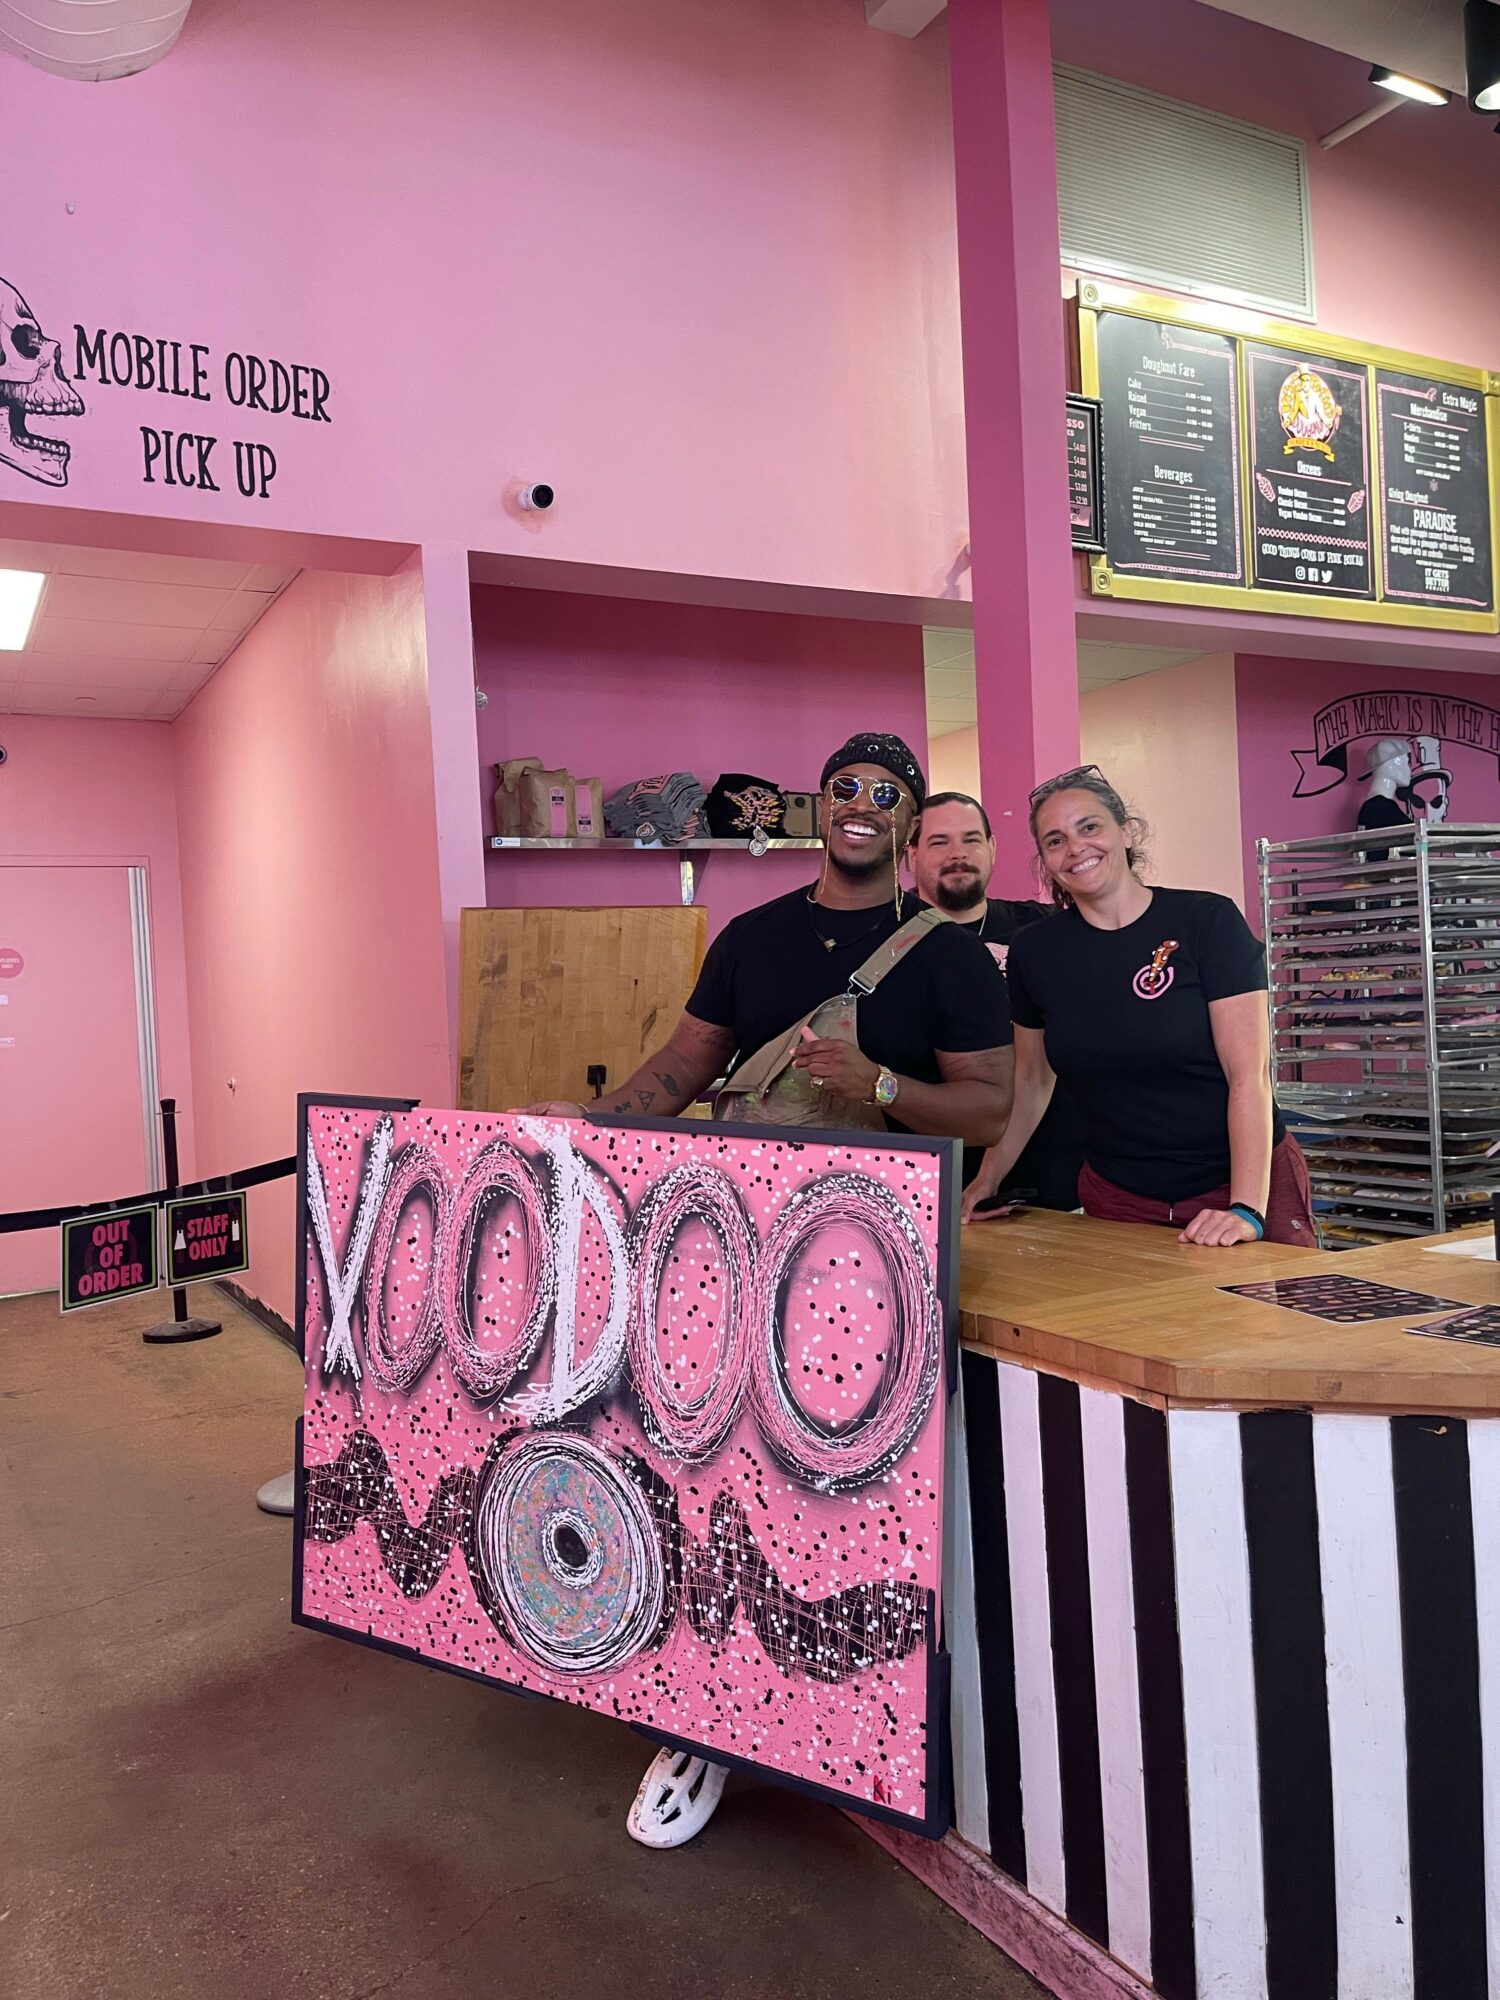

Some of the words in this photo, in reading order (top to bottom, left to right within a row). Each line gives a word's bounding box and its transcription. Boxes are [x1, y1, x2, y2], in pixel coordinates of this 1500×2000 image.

[73, 324, 210, 401] MOBILE
[225, 352, 332, 423] ORDER
[1142, 356, 1177, 375] Doughnut
[1178, 362, 1196, 378] Fare
[1128, 404, 1147, 418] Vegan
[1442, 392, 1459, 407] Extra
[1129, 418, 1152, 431] Fritters
[140, 426, 220, 492] PICK
[232, 441, 277, 499] UP
[1154, 464, 1193, 485] Beverages
[1297, 460, 1322, 477] Dozens
[1413, 508, 1457, 533] PARADISE
[1261, 543, 1278, 556] GOOD
[1278, 544, 1300, 559] THINGS
[1317, 551, 1326, 562] IN
[1326, 551, 1343, 564] PINK
[1424, 568, 1432, 576] IT
[1432, 569, 1449, 579] GETS
[1425, 576, 1450, 587] BETTER
[1352, 695, 1400, 734] MAGIC
[1405, 696, 1423, 733] IS
[1430, 697, 1449, 737] IN
[1452, 703, 1484, 745] THE
[92, 1219, 130, 1247] OUT
[187, 1213, 229, 1239] STAFF
[99, 1244, 123, 1268] OF
[188, 1236, 228, 1261] ONLY
[78, 1263, 143, 1297] ORDER
[306, 1110, 940, 1492] VOODOO
